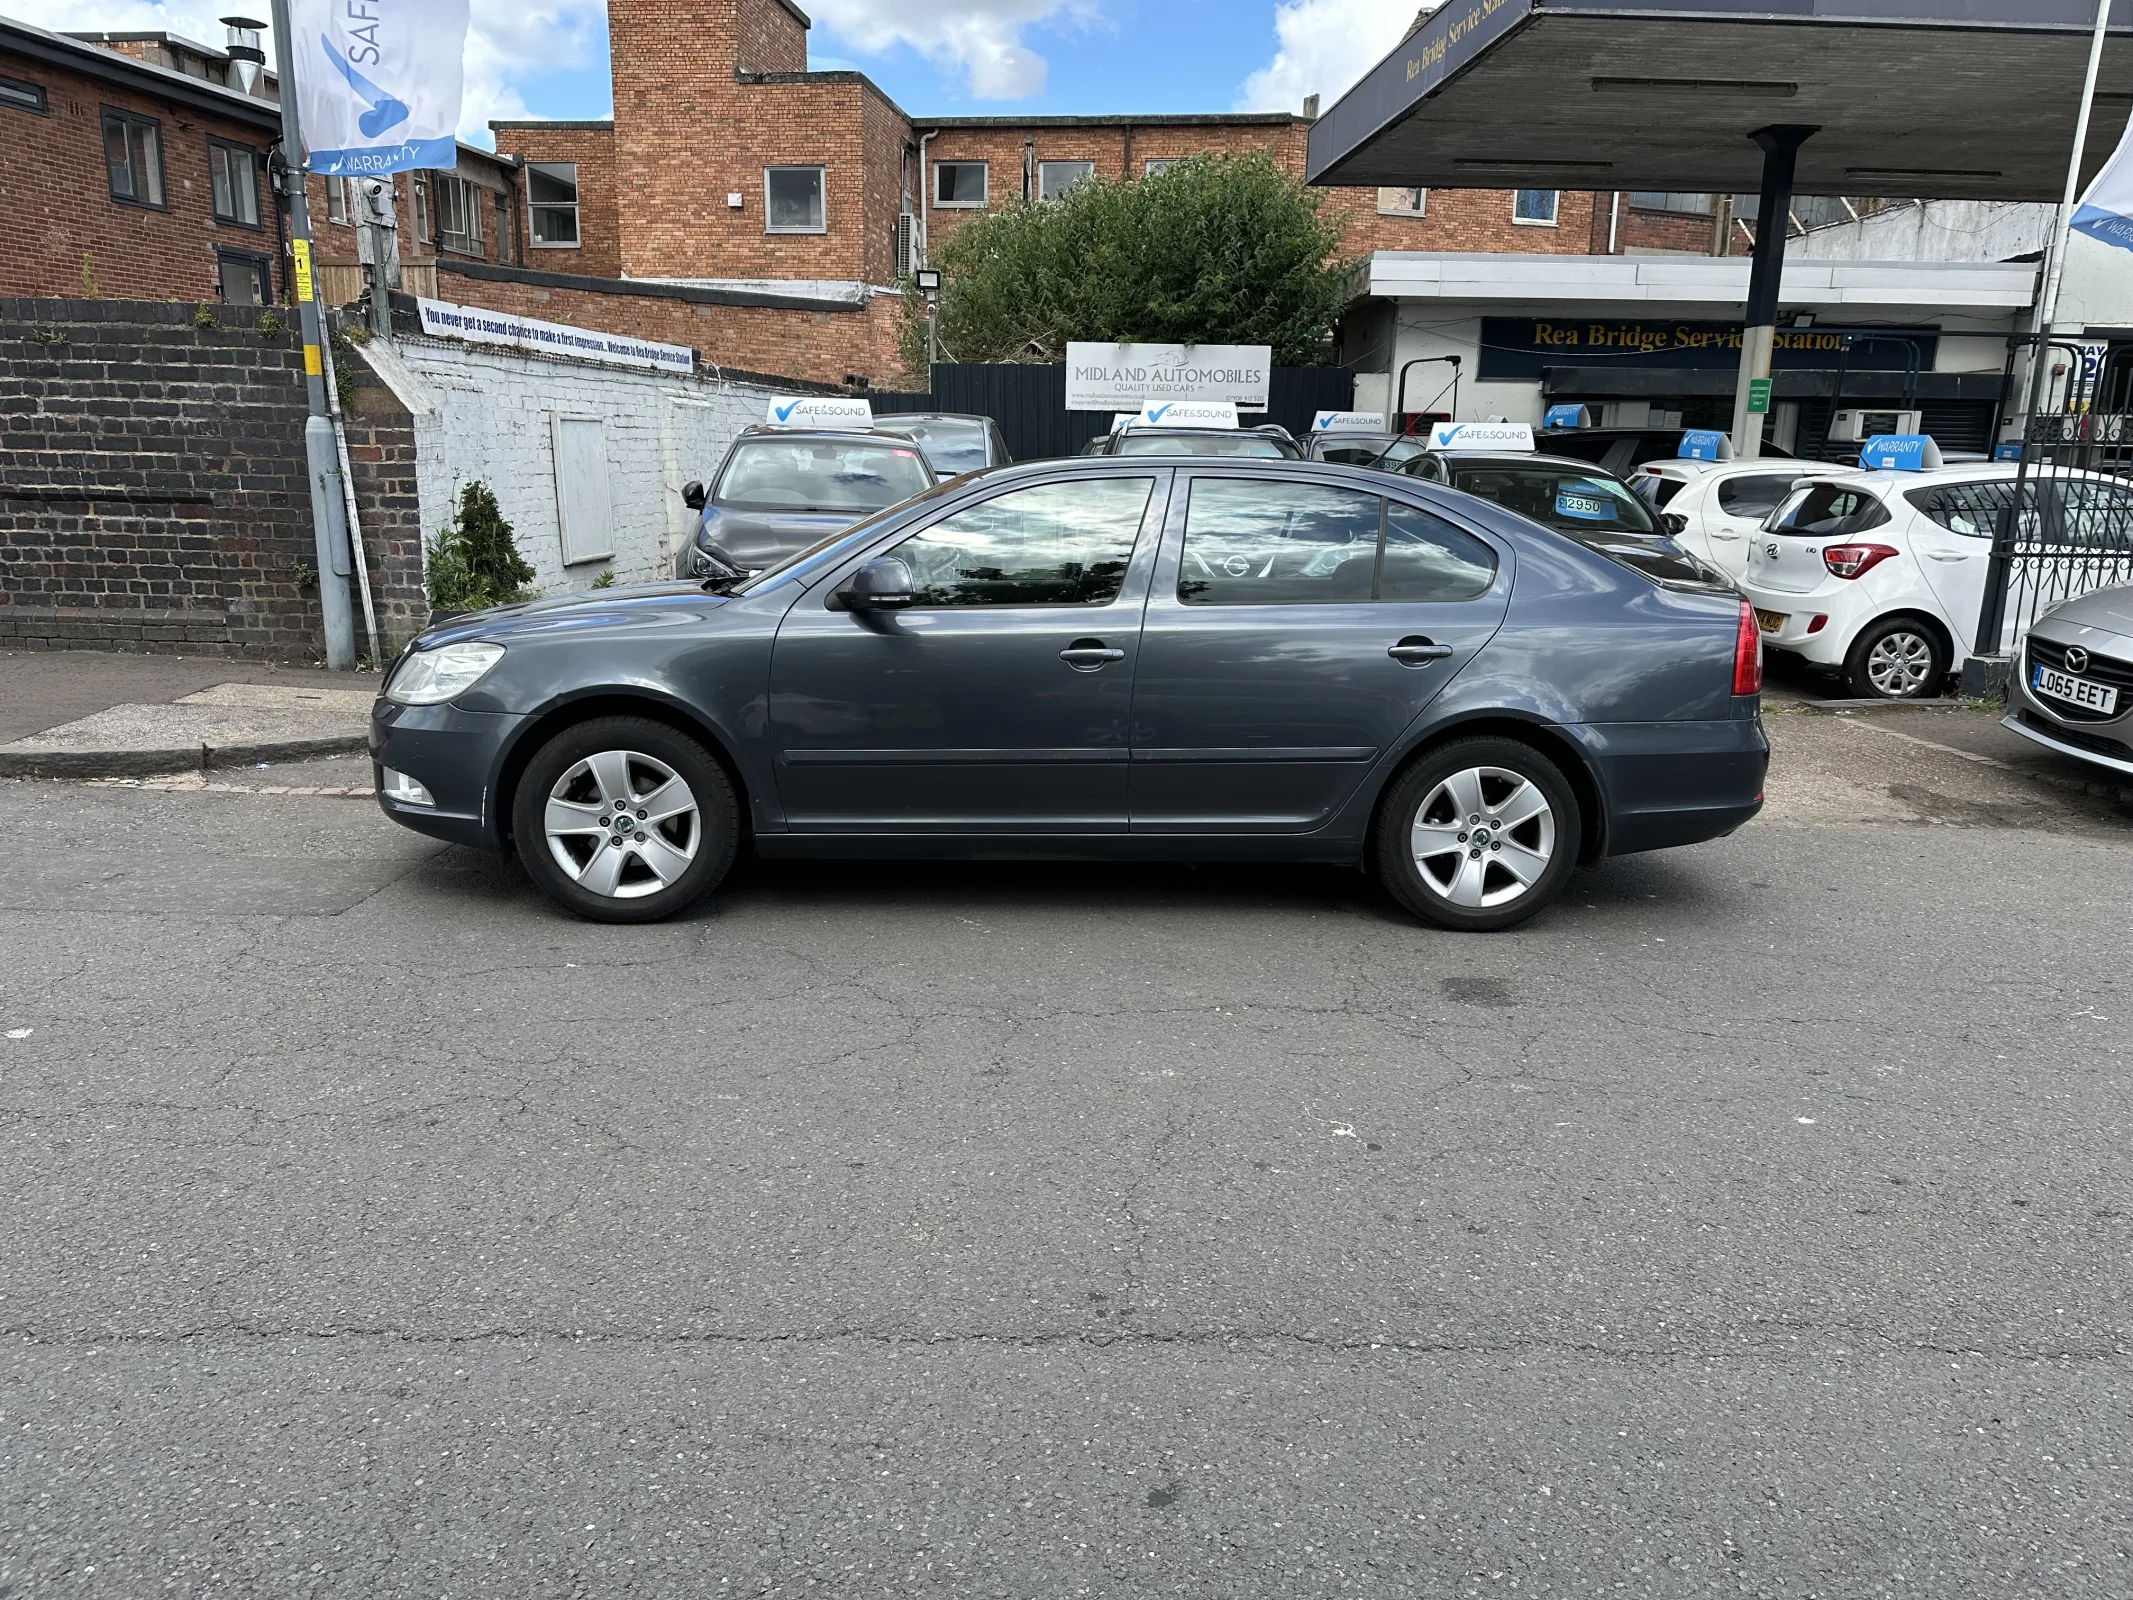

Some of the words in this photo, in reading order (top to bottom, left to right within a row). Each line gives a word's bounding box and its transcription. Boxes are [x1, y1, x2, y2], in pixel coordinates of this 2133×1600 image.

[347, 0, 379, 66] SAF
[1405, 58, 1420, 82] Rea
[1421, 35, 1447, 70] Bridge
[1448, 7, 1480, 48] Service
[296, 258, 303, 269] 1
[425, 306, 440, 323] You
[441, 312, 462, 328] never
[463, 316, 476, 330] get
[476, 318, 482, 330] a
[482, 319, 507, 335] second
[508, 323, 532, 340] chance
[532, 327, 539, 340] to
[539, 329, 556, 343] make
[556, 333, 561, 344] a
[561, 332, 574, 346] first
[607, 341, 630, 355] Welcome
[630, 345, 636, 356] to
[644, 346, 660, 361] Bridge
[660, 349, 676, 362] Service
[675, 351, 690, 365] Station
[1533, 323, 1579, 345] Rea
[1586, 324, 1668, 352] Bridge
[1674, 326, 1743, 348] Servic
[1075, 366, 1147, 382] MIDLAND
[1150, 368, 1261, 384] AUTOMOBILES
[1114, 383, 1150, 392] QUALITY
[1152, 383, 1172, 392] USED
[1174, 384, 1194, 392] CARS
[795, 404, 866, 416] SAFE&SOUND
[1166, 408, 1232, 418] SAFE&SOUND
[1333, 417, 1382, 425] SAFE&SOUND
[1457, 430, 1527, 440] SAFE&SOUND
[1690, 434, 1719, 447] WARRANTY
[1877, 440, 1921, 453] WARRANTY
[2038, 668, 2074, 697] LO65
[2076, 681, 2111, 708] EET
